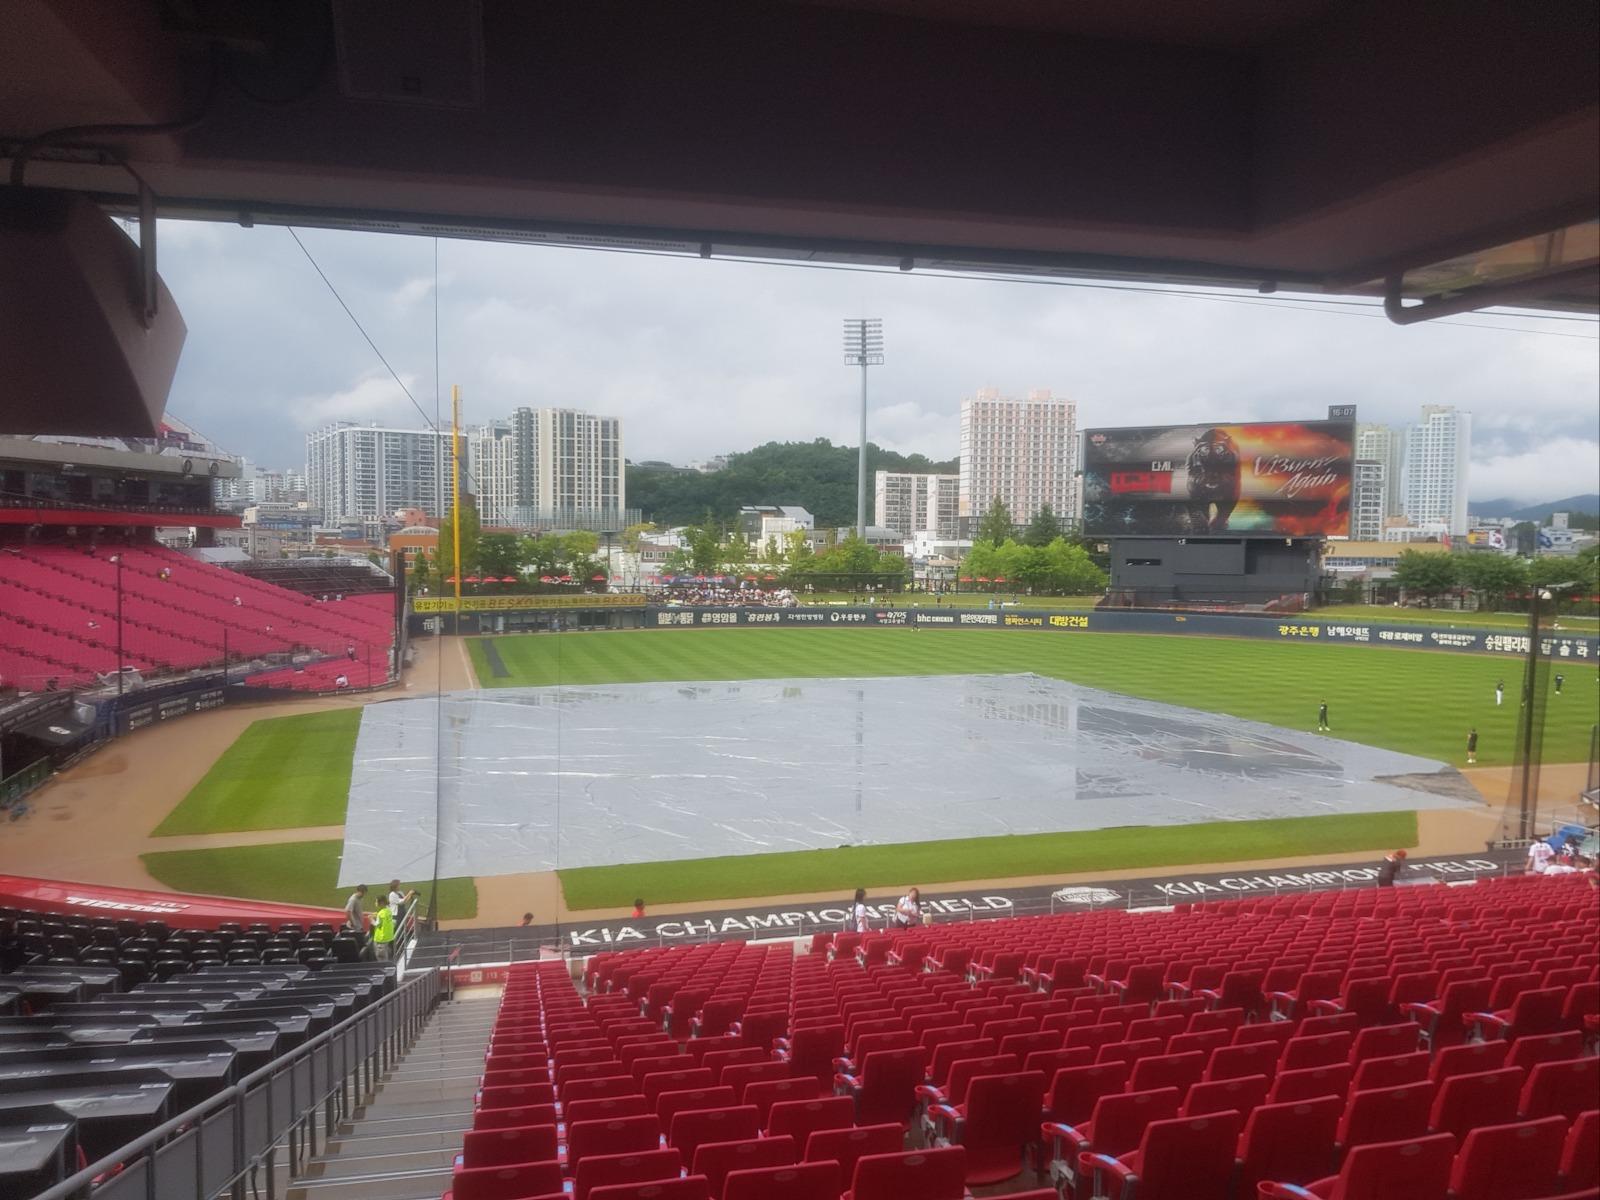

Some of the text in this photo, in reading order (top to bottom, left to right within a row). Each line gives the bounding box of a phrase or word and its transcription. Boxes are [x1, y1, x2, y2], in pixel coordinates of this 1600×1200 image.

[1333, 408, 1353, 417] 16:07
[1273, 470, 1338, 498] Again
[917, 613, 931, 623] bhc
[1278, 625, 1320, 637] 광주은행
[1154, 882, 1223, 896] KIA
[1220, 867, 1381, 891] CHAMPION
[570, 926, 646, 946] KIA
